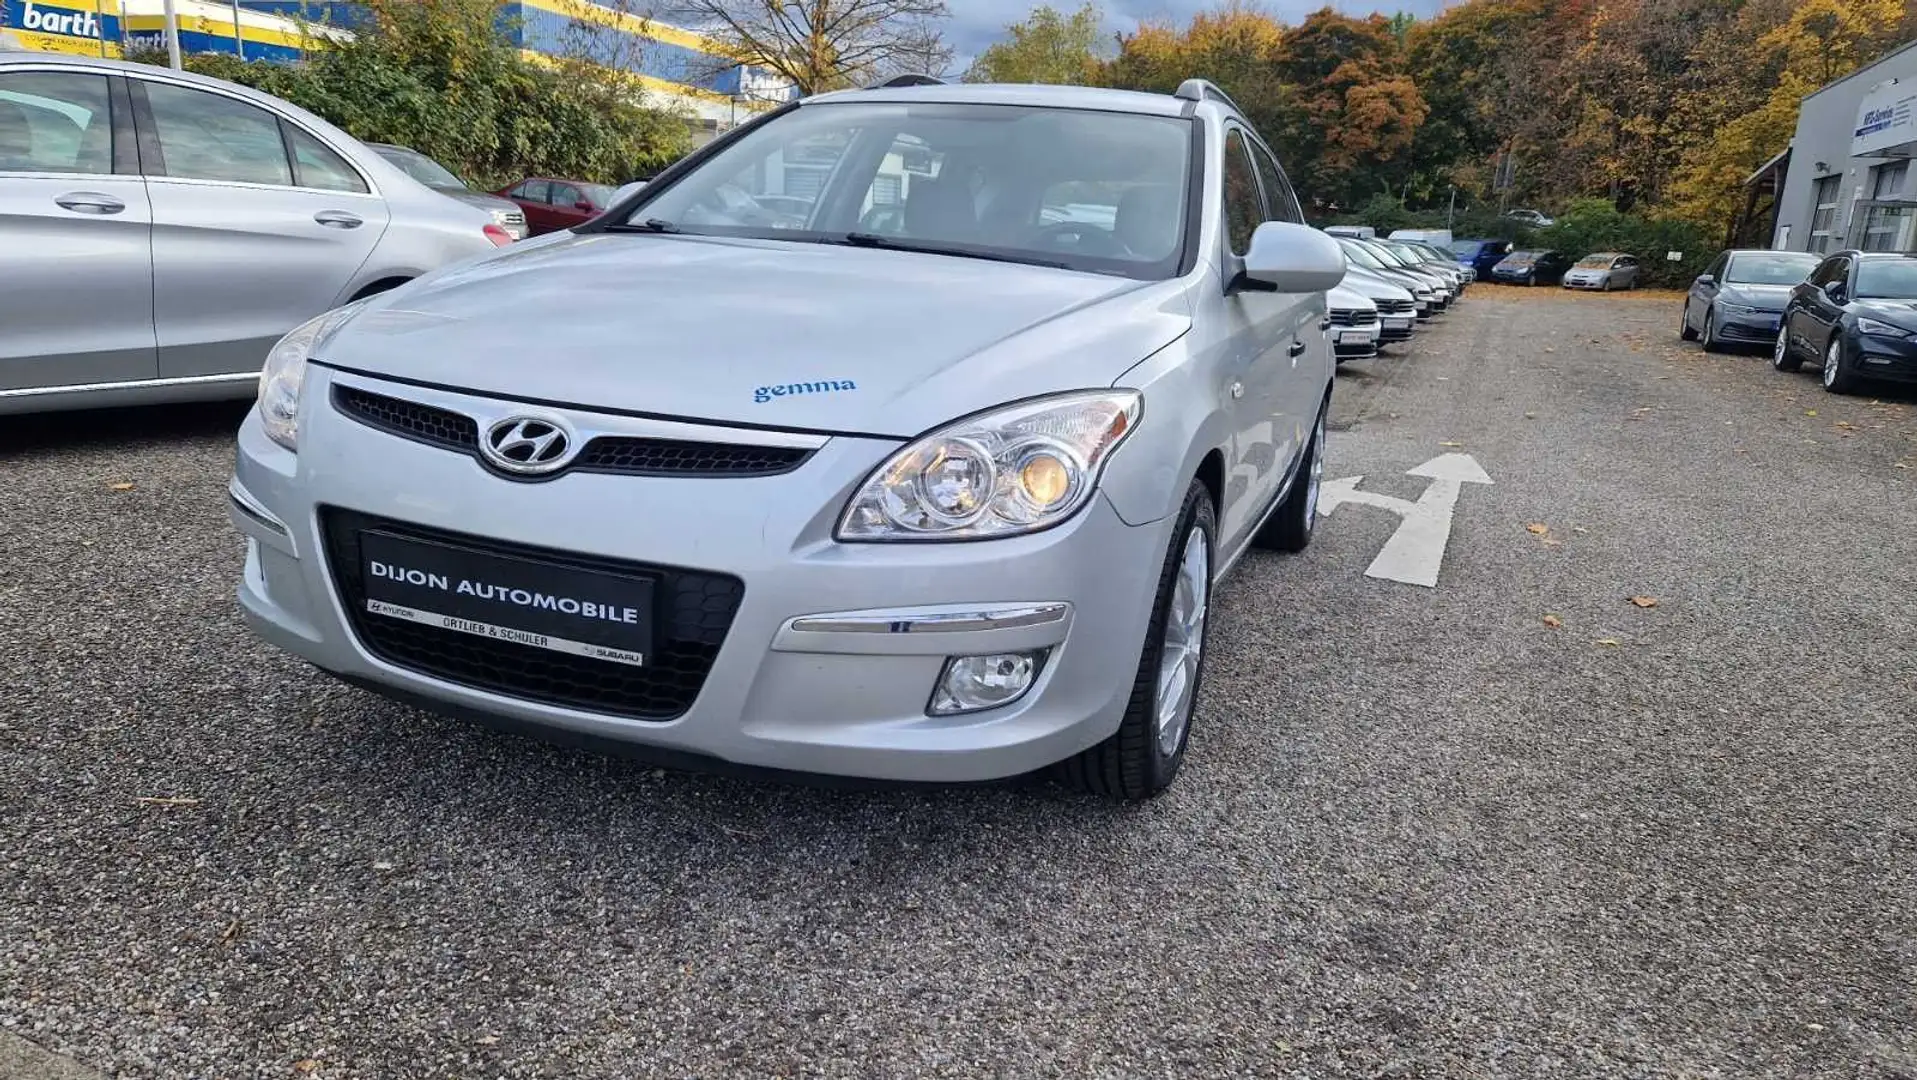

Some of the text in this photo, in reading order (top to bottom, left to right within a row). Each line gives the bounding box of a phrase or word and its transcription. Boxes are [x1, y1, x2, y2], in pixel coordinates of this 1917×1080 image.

[23, 2, 99, 37] barth
[754, 379, 857, 404] gemma
[371, 561, 638, 624] DIJON AUTOMOBILE
[443, 617, 486, 634] ORTLIEB
[488, 624, 498, 637] &
[596, 648, 639, 662] SUBARU
